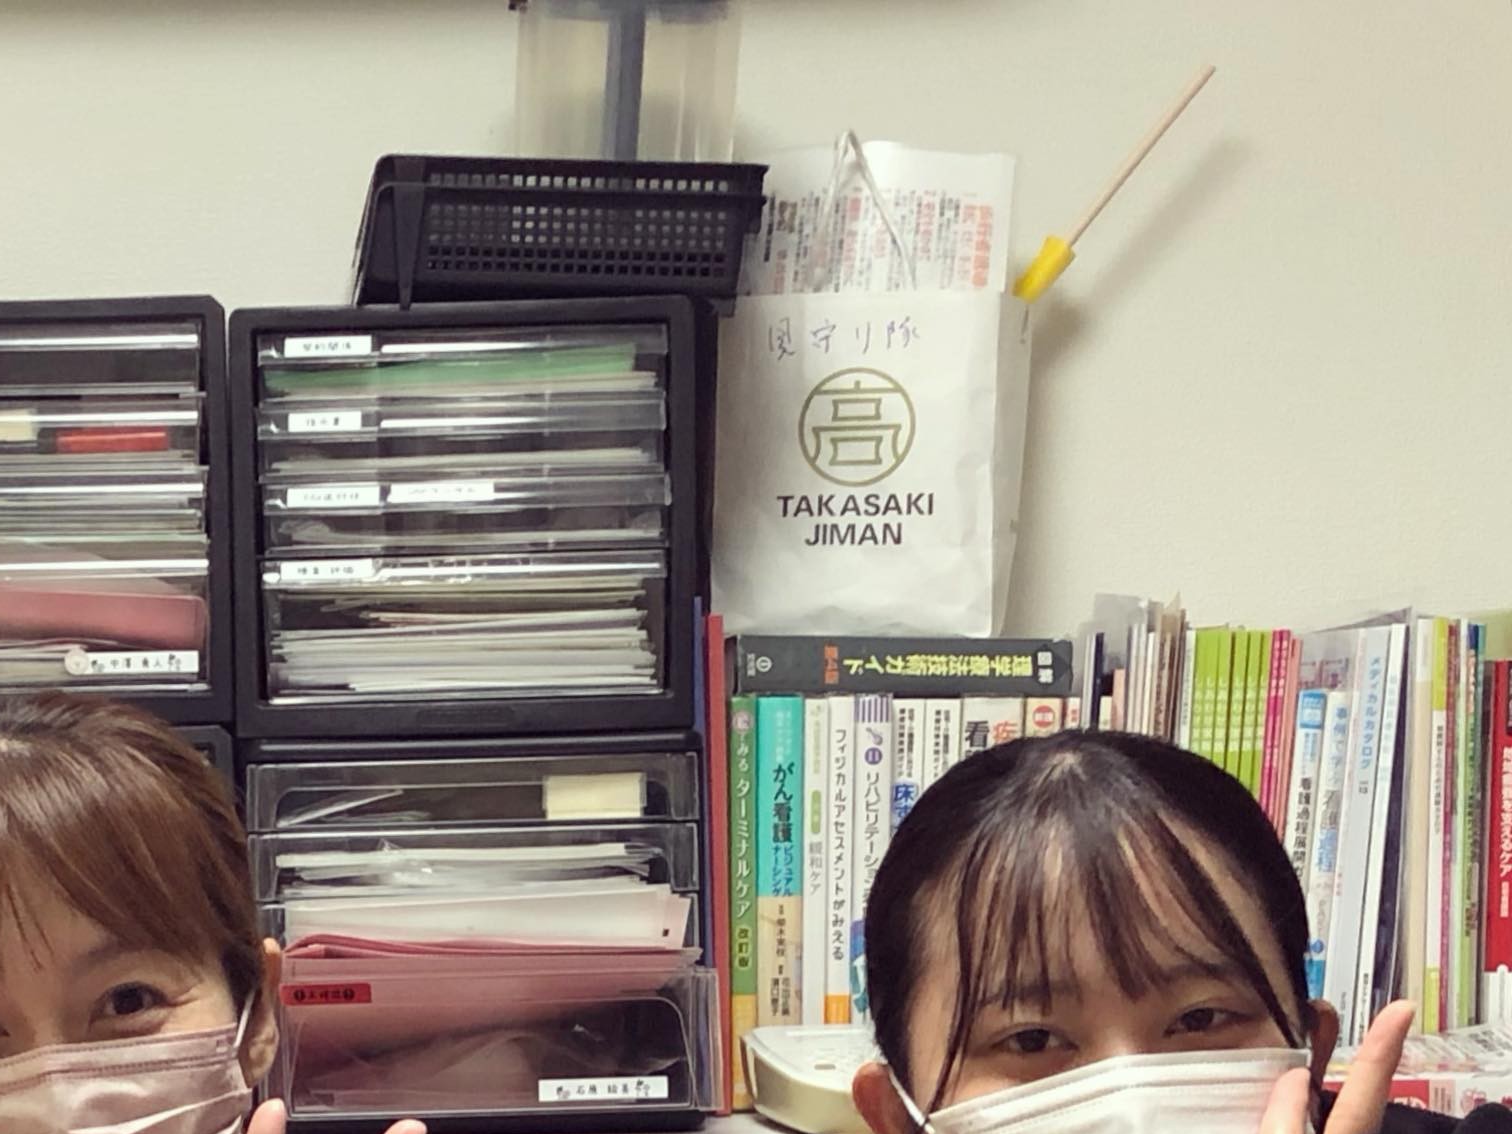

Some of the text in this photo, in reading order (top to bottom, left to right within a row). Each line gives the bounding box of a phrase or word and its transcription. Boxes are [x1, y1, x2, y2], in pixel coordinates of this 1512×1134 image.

[777, 492, 935, 519] TAKASAKI
[805, 523, 903, 546] JIMAN
[771, 762, 795, 843] がん看護
[736, 778, 752, 918] ターミナルケア
[832, 729, 847, 962] フィジカルアセスメントがみえる
